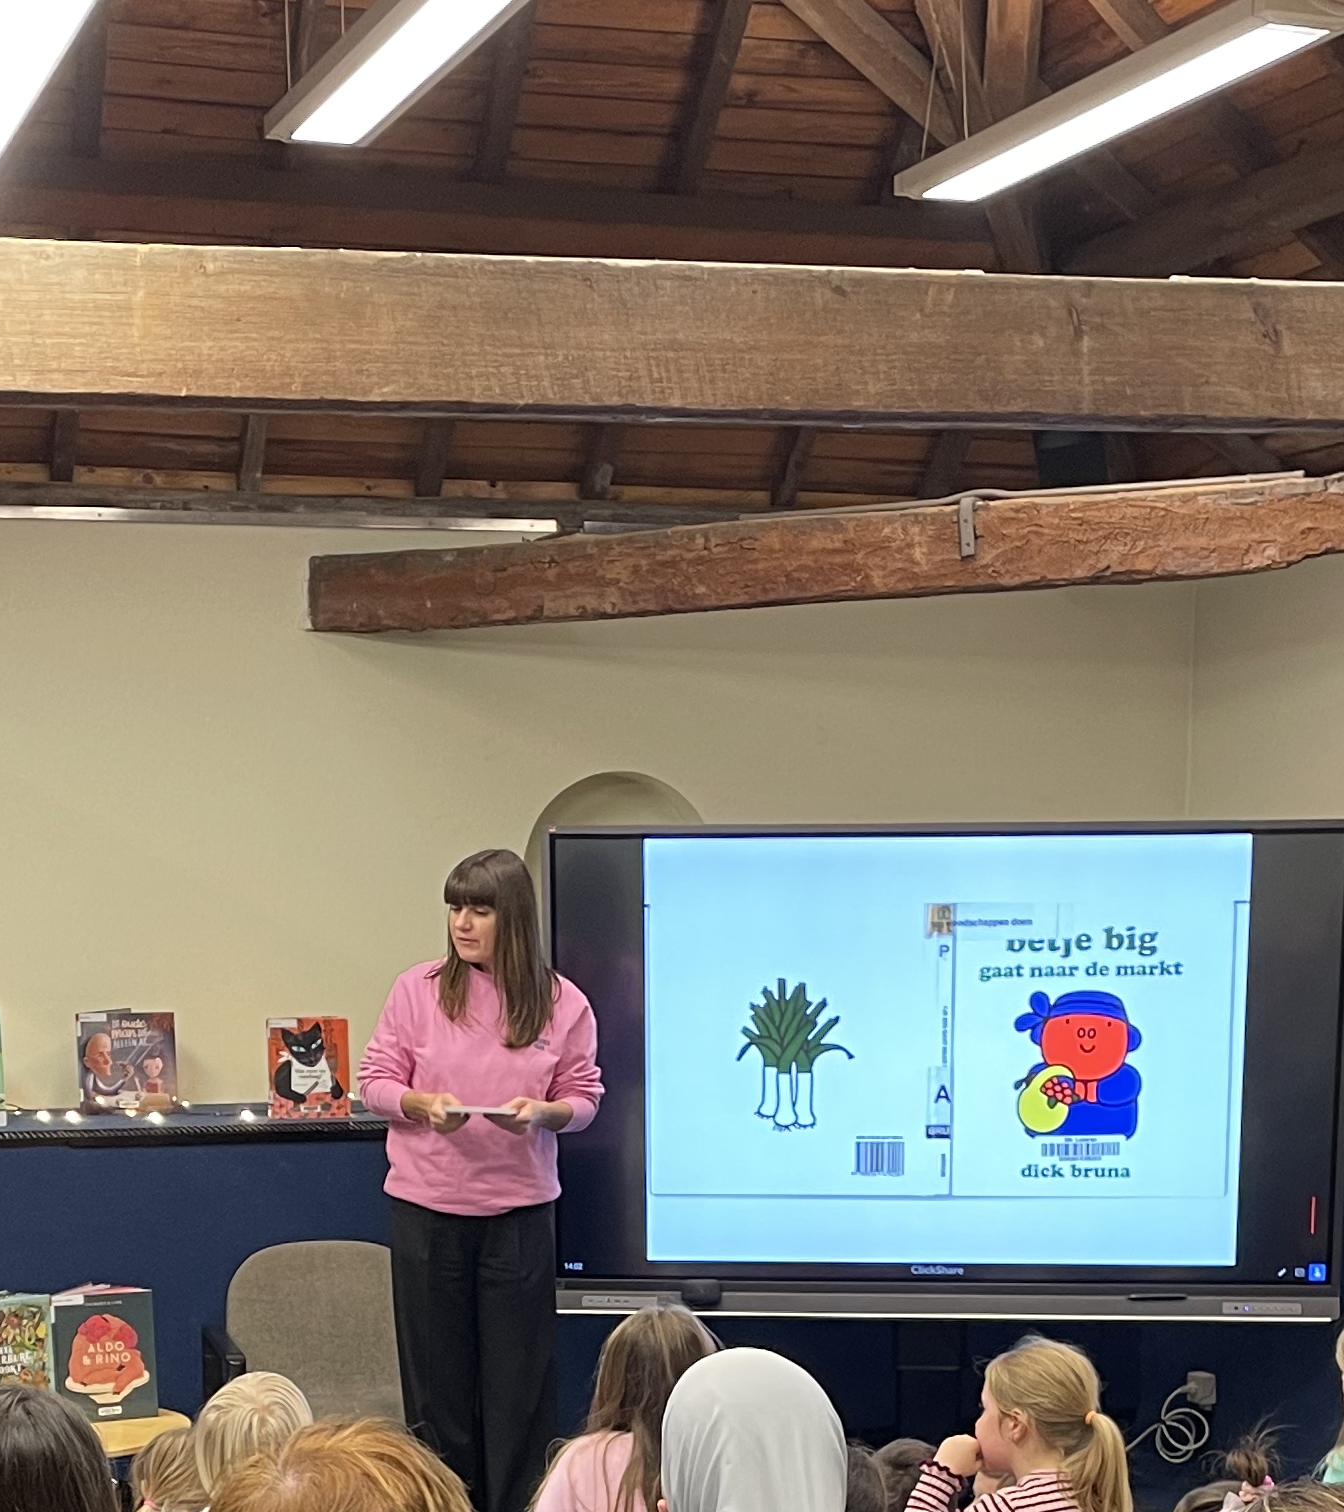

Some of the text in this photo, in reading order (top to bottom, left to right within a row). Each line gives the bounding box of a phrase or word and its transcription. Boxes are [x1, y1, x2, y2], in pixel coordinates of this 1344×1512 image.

[1102, 925, 1159, 957] big
[938, 943, 951, 958] P
[978, 960, 1184, 983] gaat naar de markt
[933, 1083, 953, 1104] A
[1020, 1163, 1131, 1179] dick bruna
[87, 1340, 125, 1353] ALDO
[82, 1351, 132, 1366] & RINO
